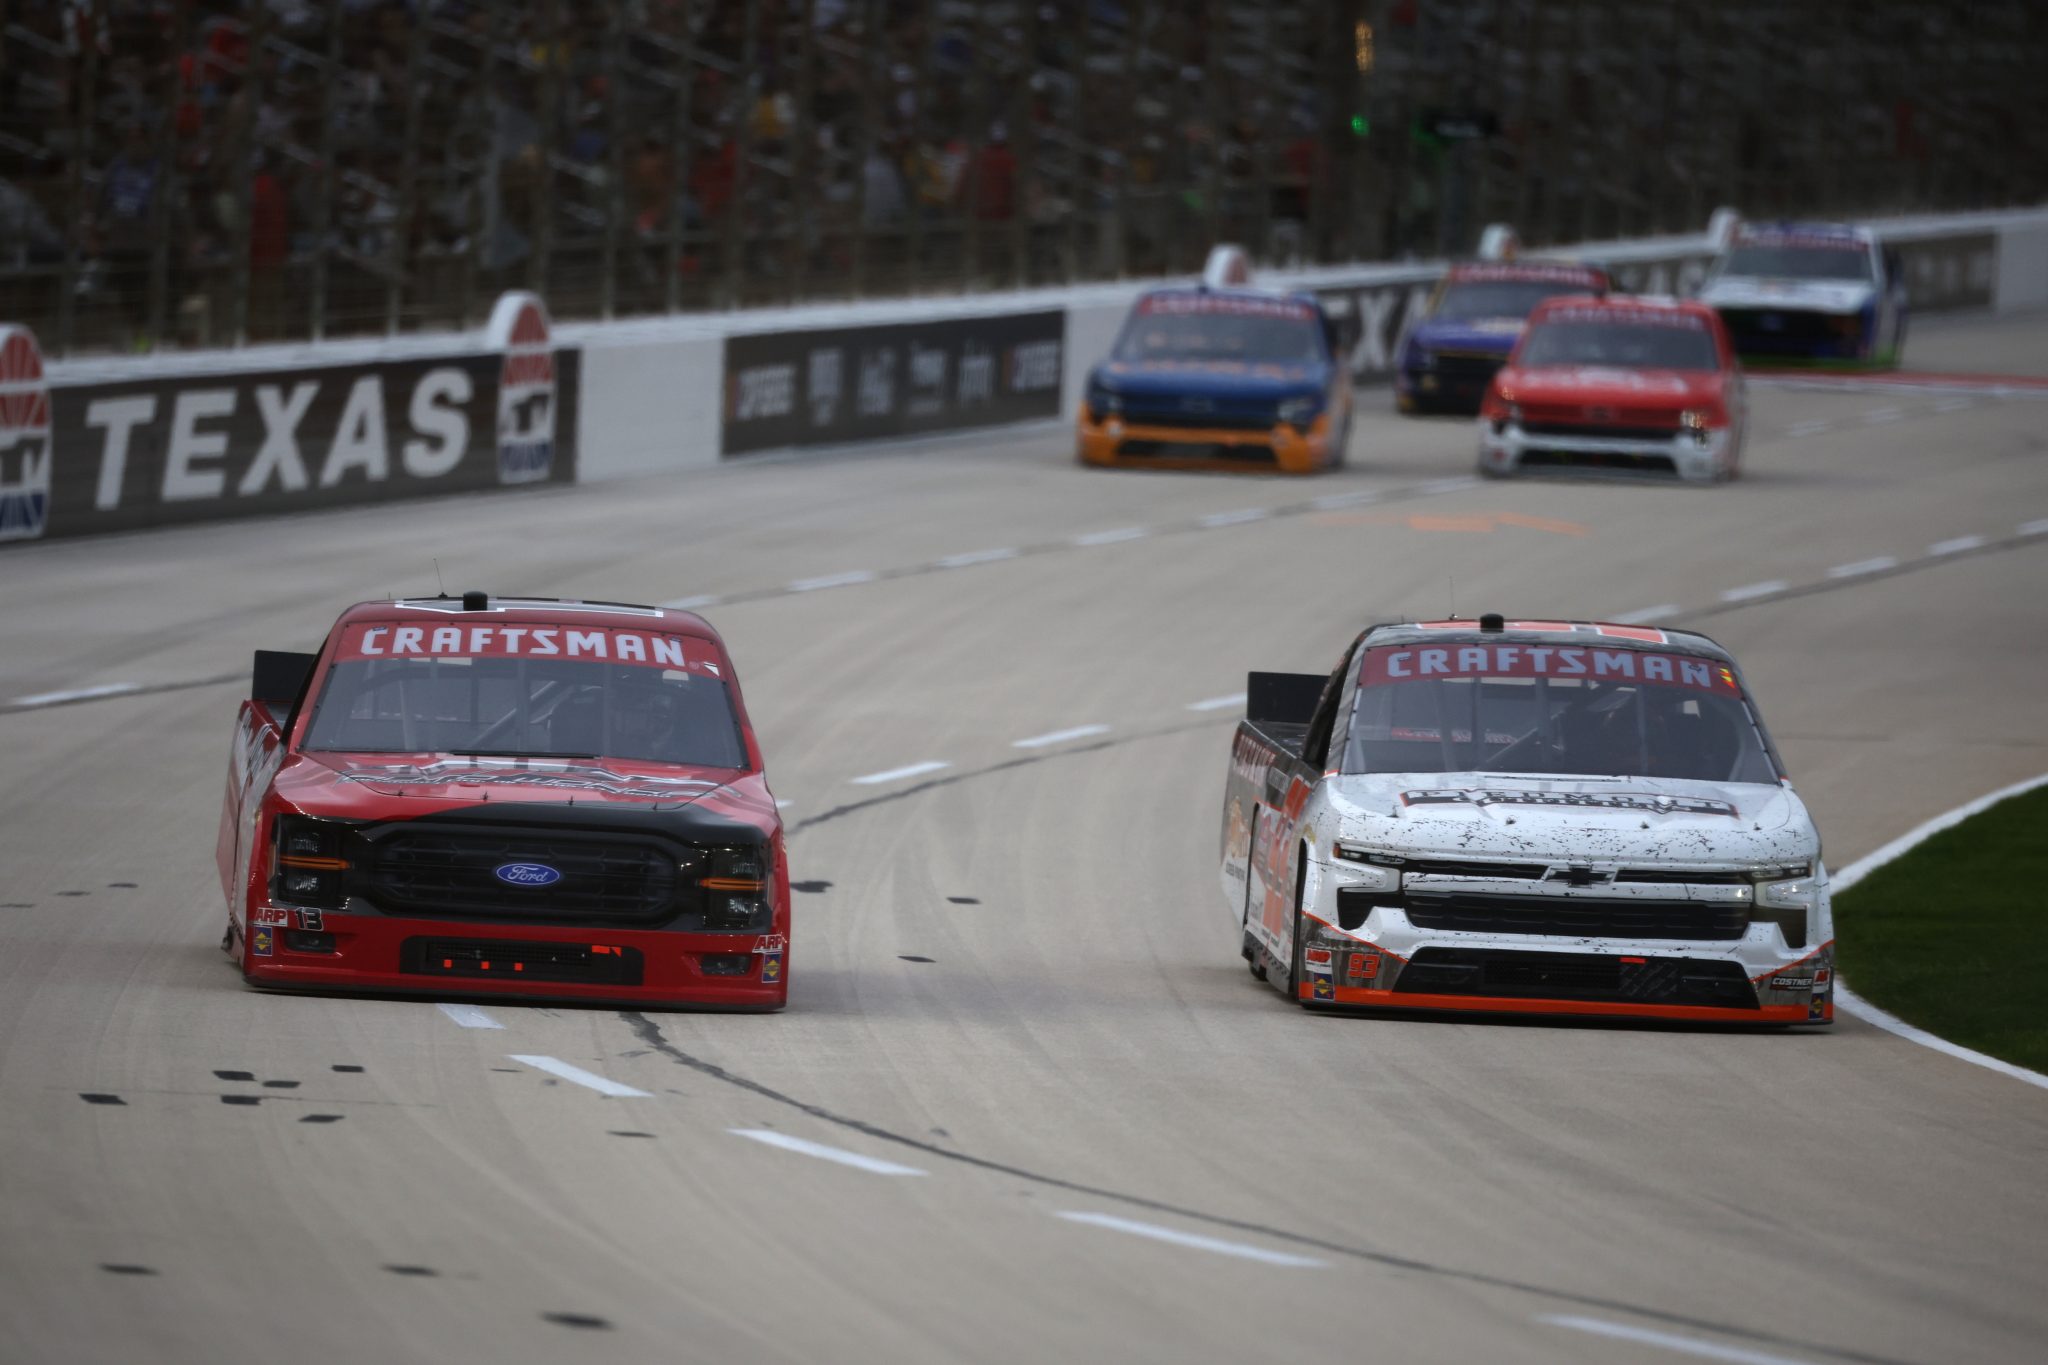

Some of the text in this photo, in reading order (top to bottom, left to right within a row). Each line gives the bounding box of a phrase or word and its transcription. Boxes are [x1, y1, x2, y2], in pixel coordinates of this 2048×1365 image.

[85, 367, 474, 510] TEXAS
[360, 626, 686, 667] CRAFTSMAN
[1387, 647, 1711, 689] CRAFTSMAN
[507, 865, 549, 884] Ford
[255, 908, 288, 924] ARP
[295, 907, 324, 931] 13
[753, 935, 783, 950] ARP
[1348, 953, 1380, 979] 93
[1772, 977, 1812, 986] COSTNER
